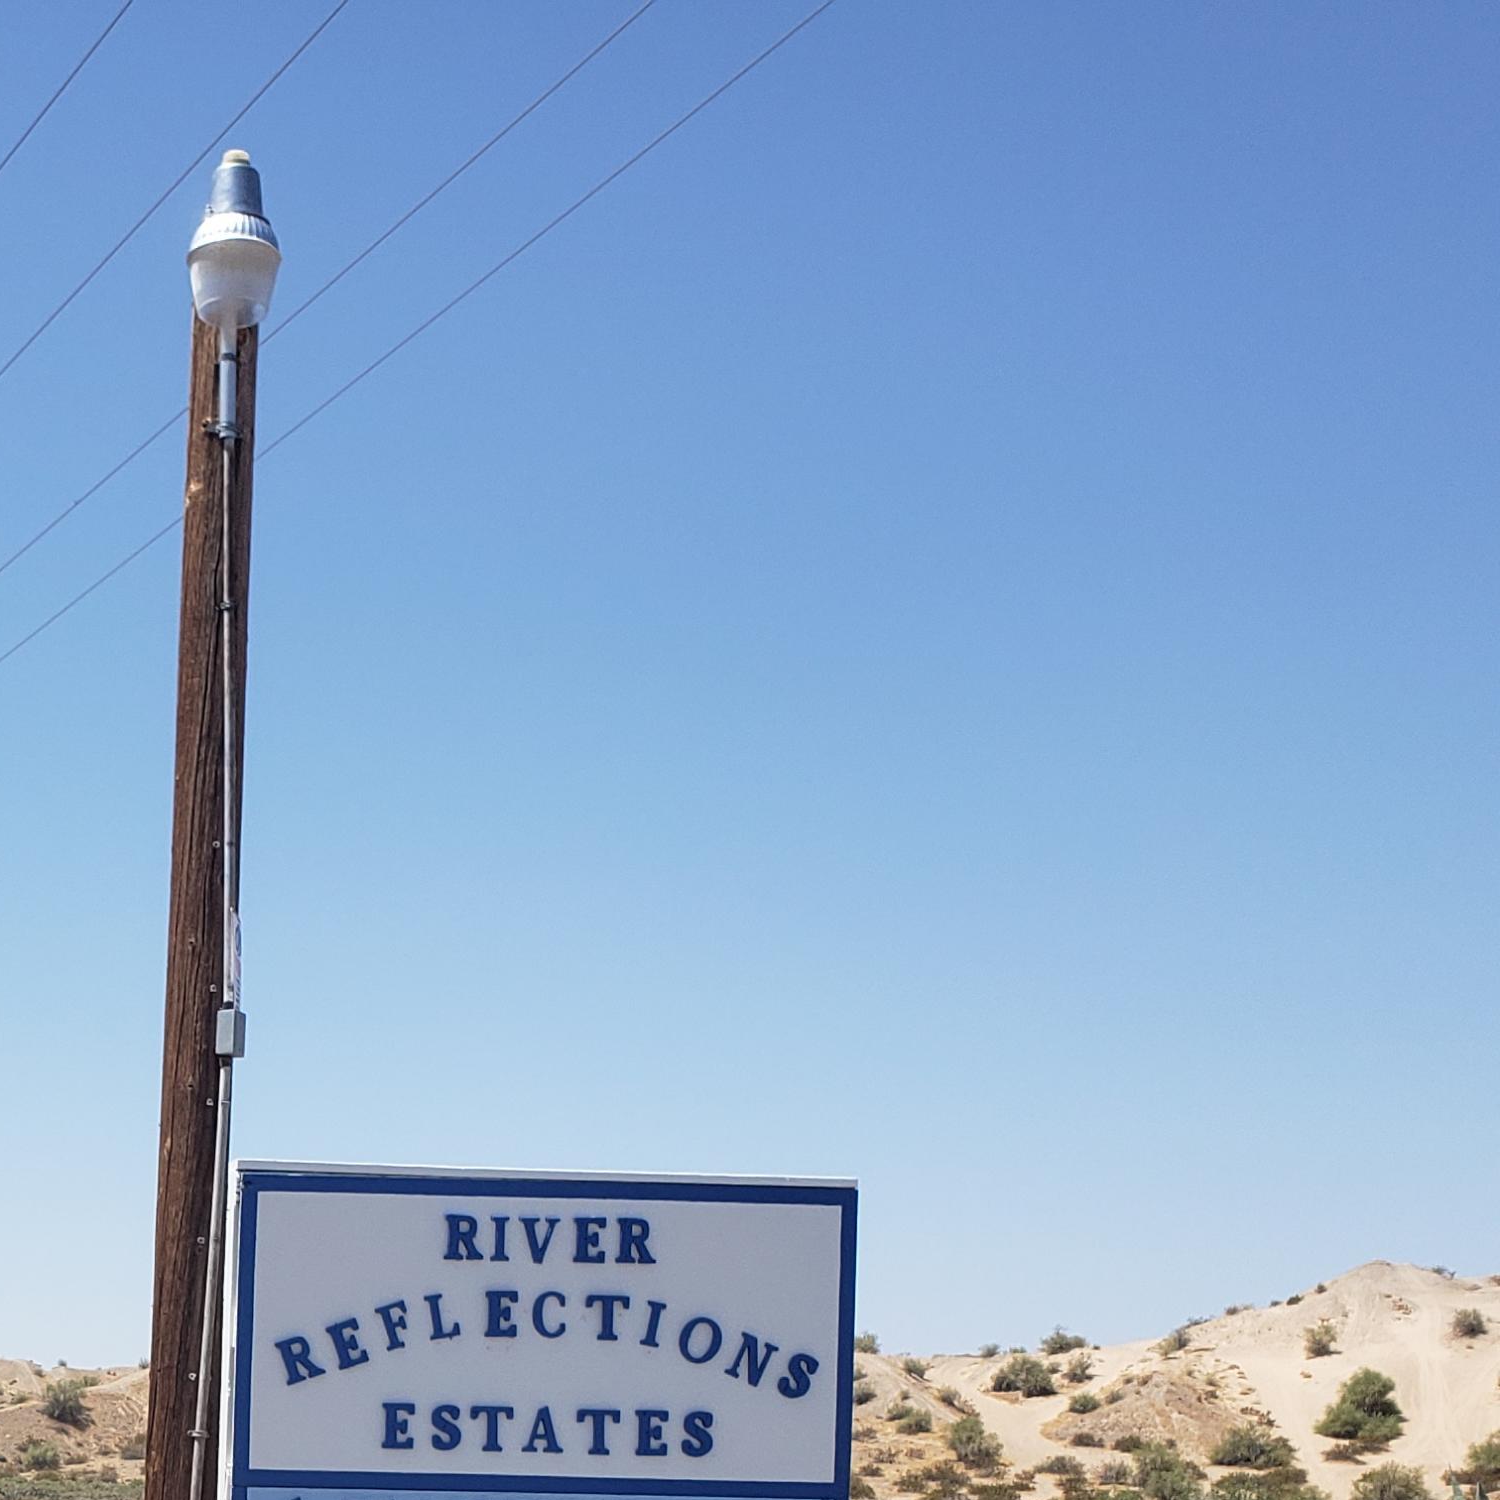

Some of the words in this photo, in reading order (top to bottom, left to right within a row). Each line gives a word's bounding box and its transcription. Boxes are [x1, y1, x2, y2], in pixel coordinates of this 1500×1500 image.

[443, 1213, 657, 1265] RIVER
[275, 1290, 819, 1399] REFLECTIONS
[381, 1402, 715, 1458] ESTATES
